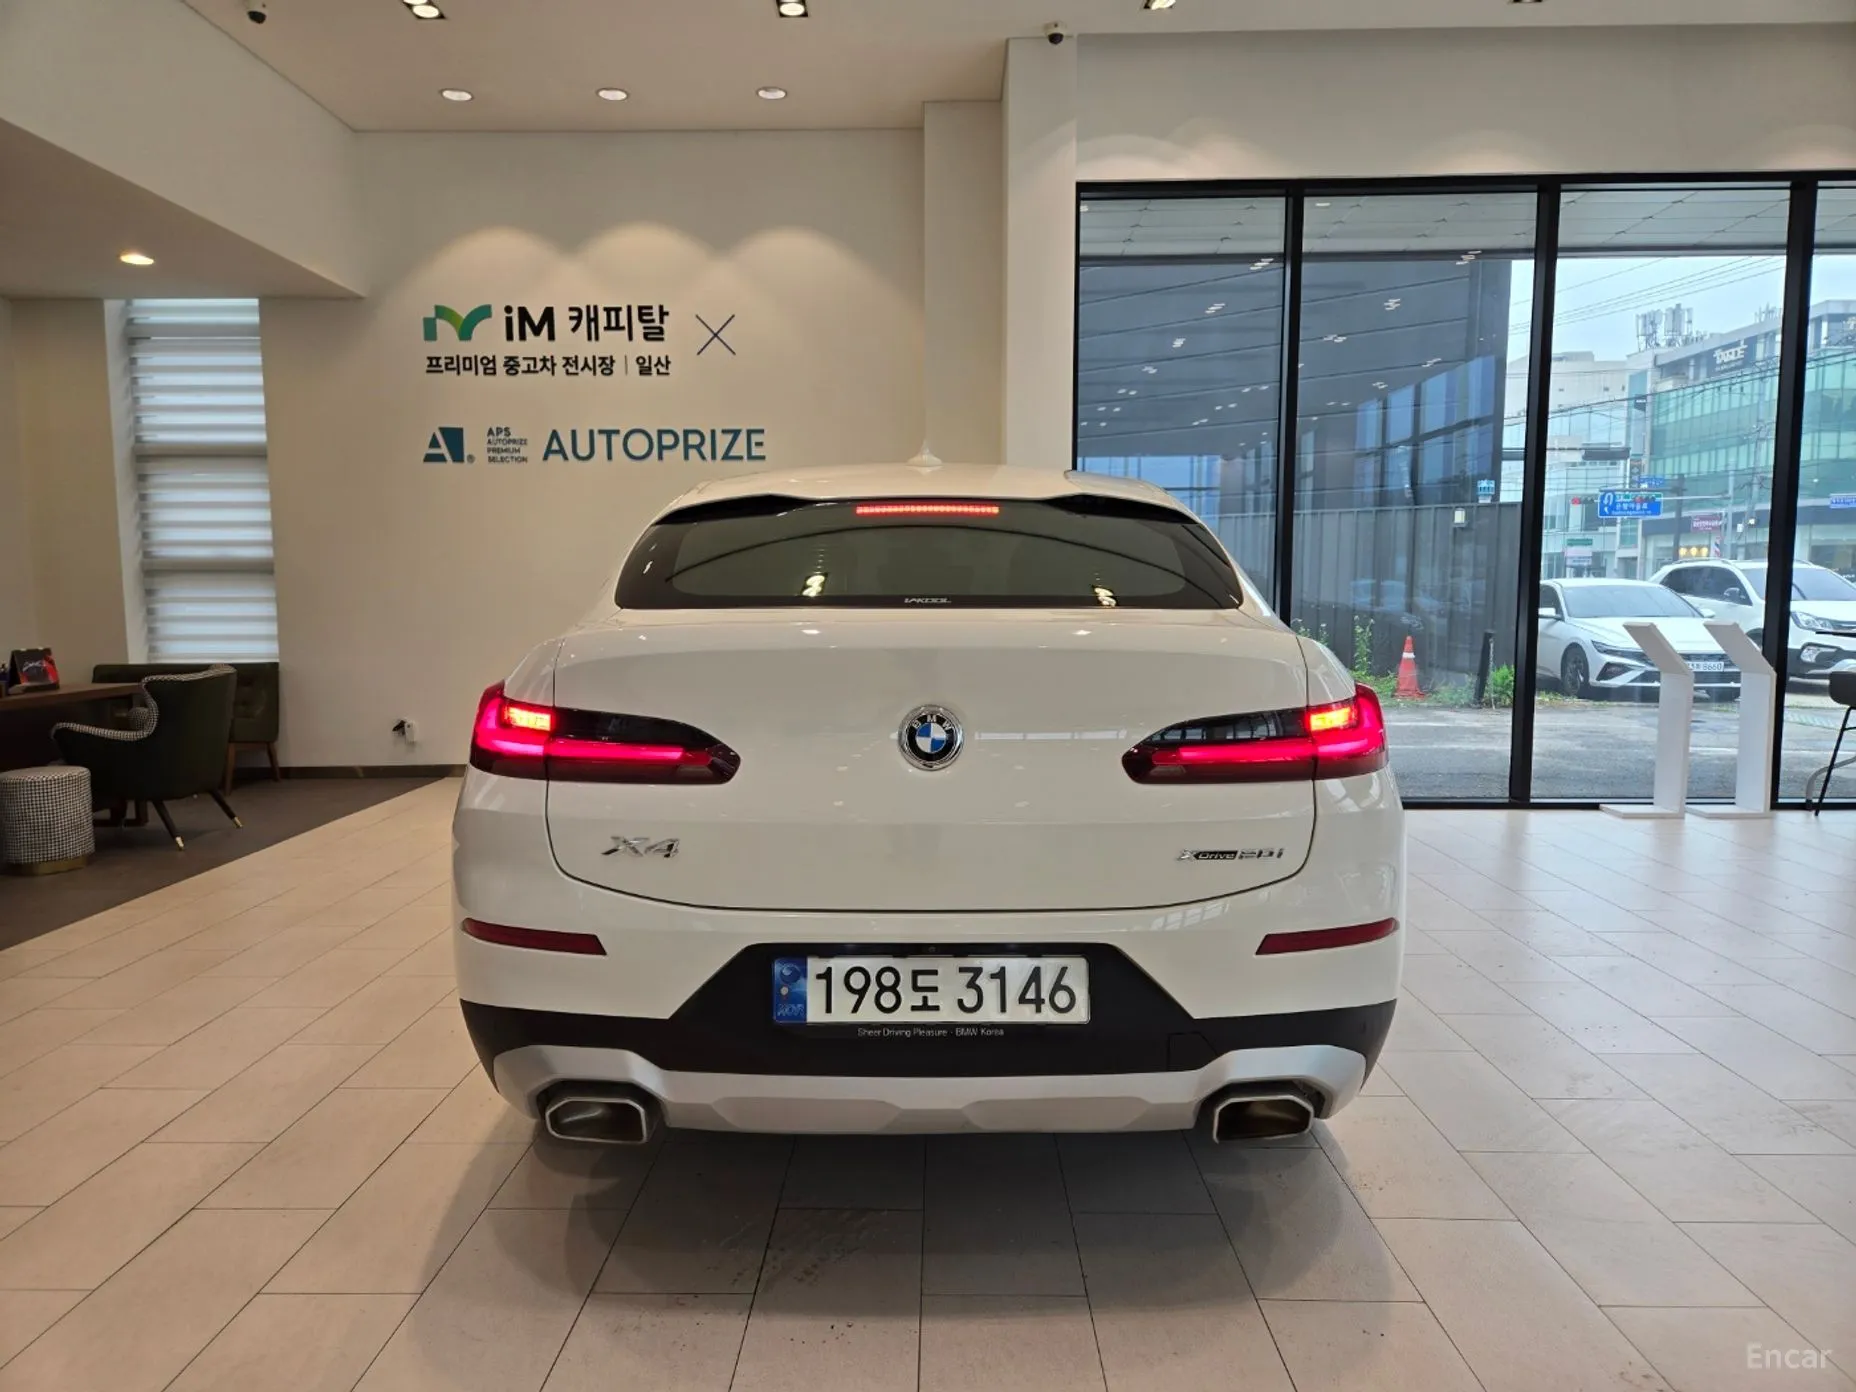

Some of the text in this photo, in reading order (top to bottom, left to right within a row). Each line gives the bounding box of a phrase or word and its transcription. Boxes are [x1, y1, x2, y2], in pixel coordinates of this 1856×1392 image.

[503, 304, 556, 342] iM
[567, 304, 670, 342] 캐피탈
[425, 355, 672, 376] 프리미엄 중고차 전시장 일산
[487, 426, 511, 437] APS
[487, 438, 528, 446] AUTOPRIZE
[542, 428, 767, 463] AUTOPRIZE
[487, 455, 528, 463] SELECTION
[911, 714, 954, 732] BMW
[601, 836, 680, 858] X4
[815, 966, 1077, 1014] 198도 3146
[857, 1027, 1004, 1038] Sheer Driving Pleasure BMW Korea
